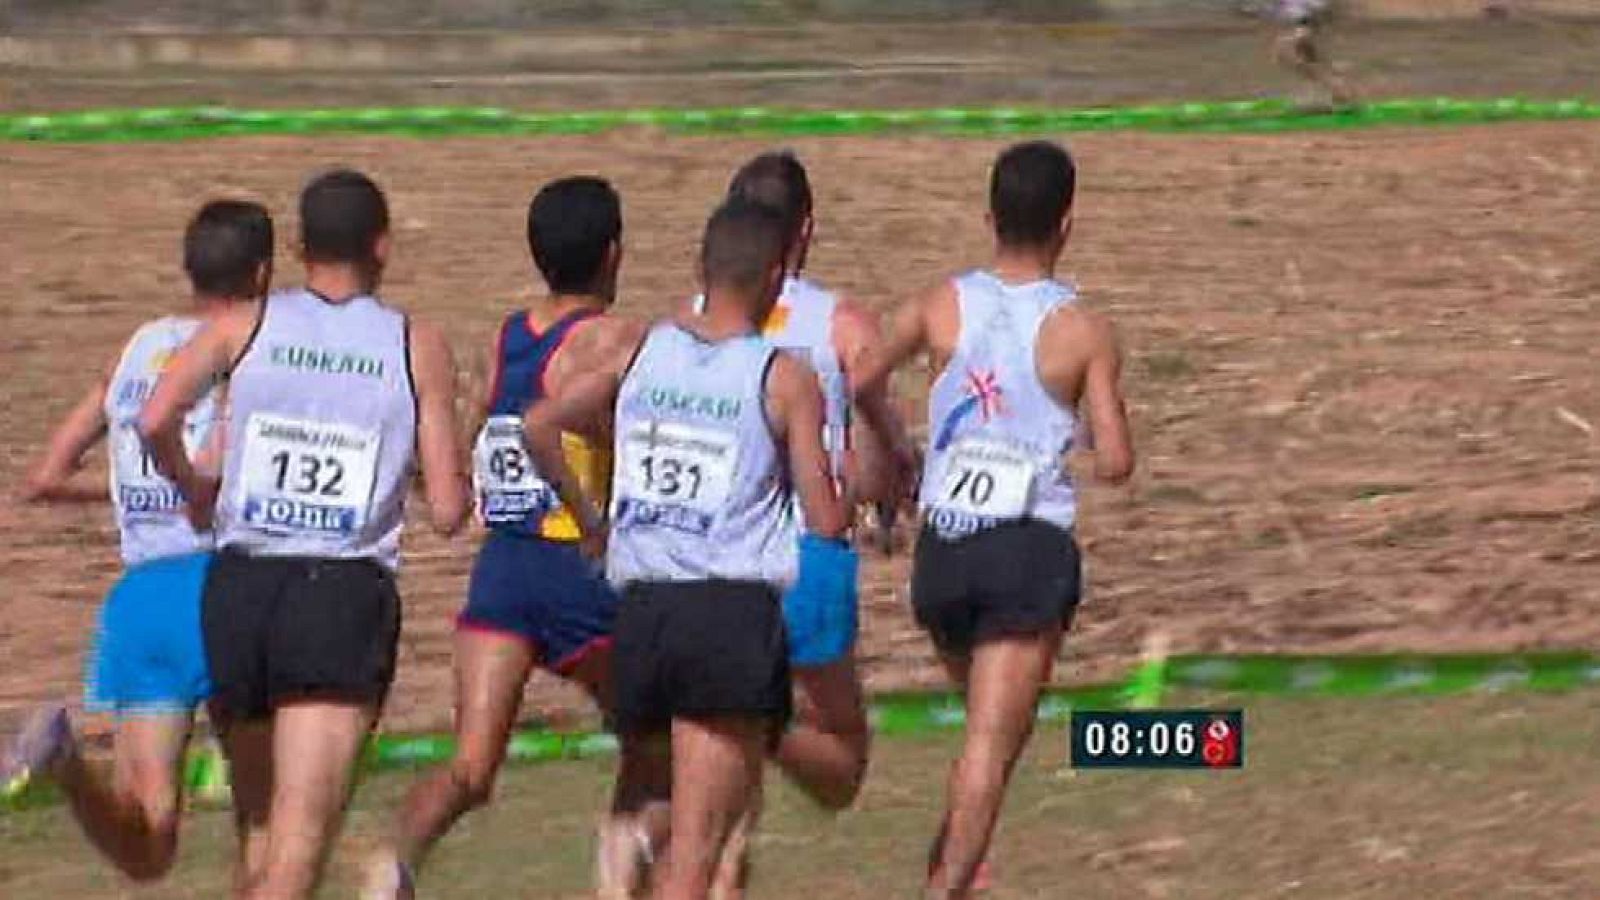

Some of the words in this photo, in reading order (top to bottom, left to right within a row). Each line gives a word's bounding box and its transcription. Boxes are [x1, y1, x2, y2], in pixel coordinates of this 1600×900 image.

[271, 450, 345, 497] 132
[640, 455, 702, 499] 131
[950, 467, 994, 506] 70
